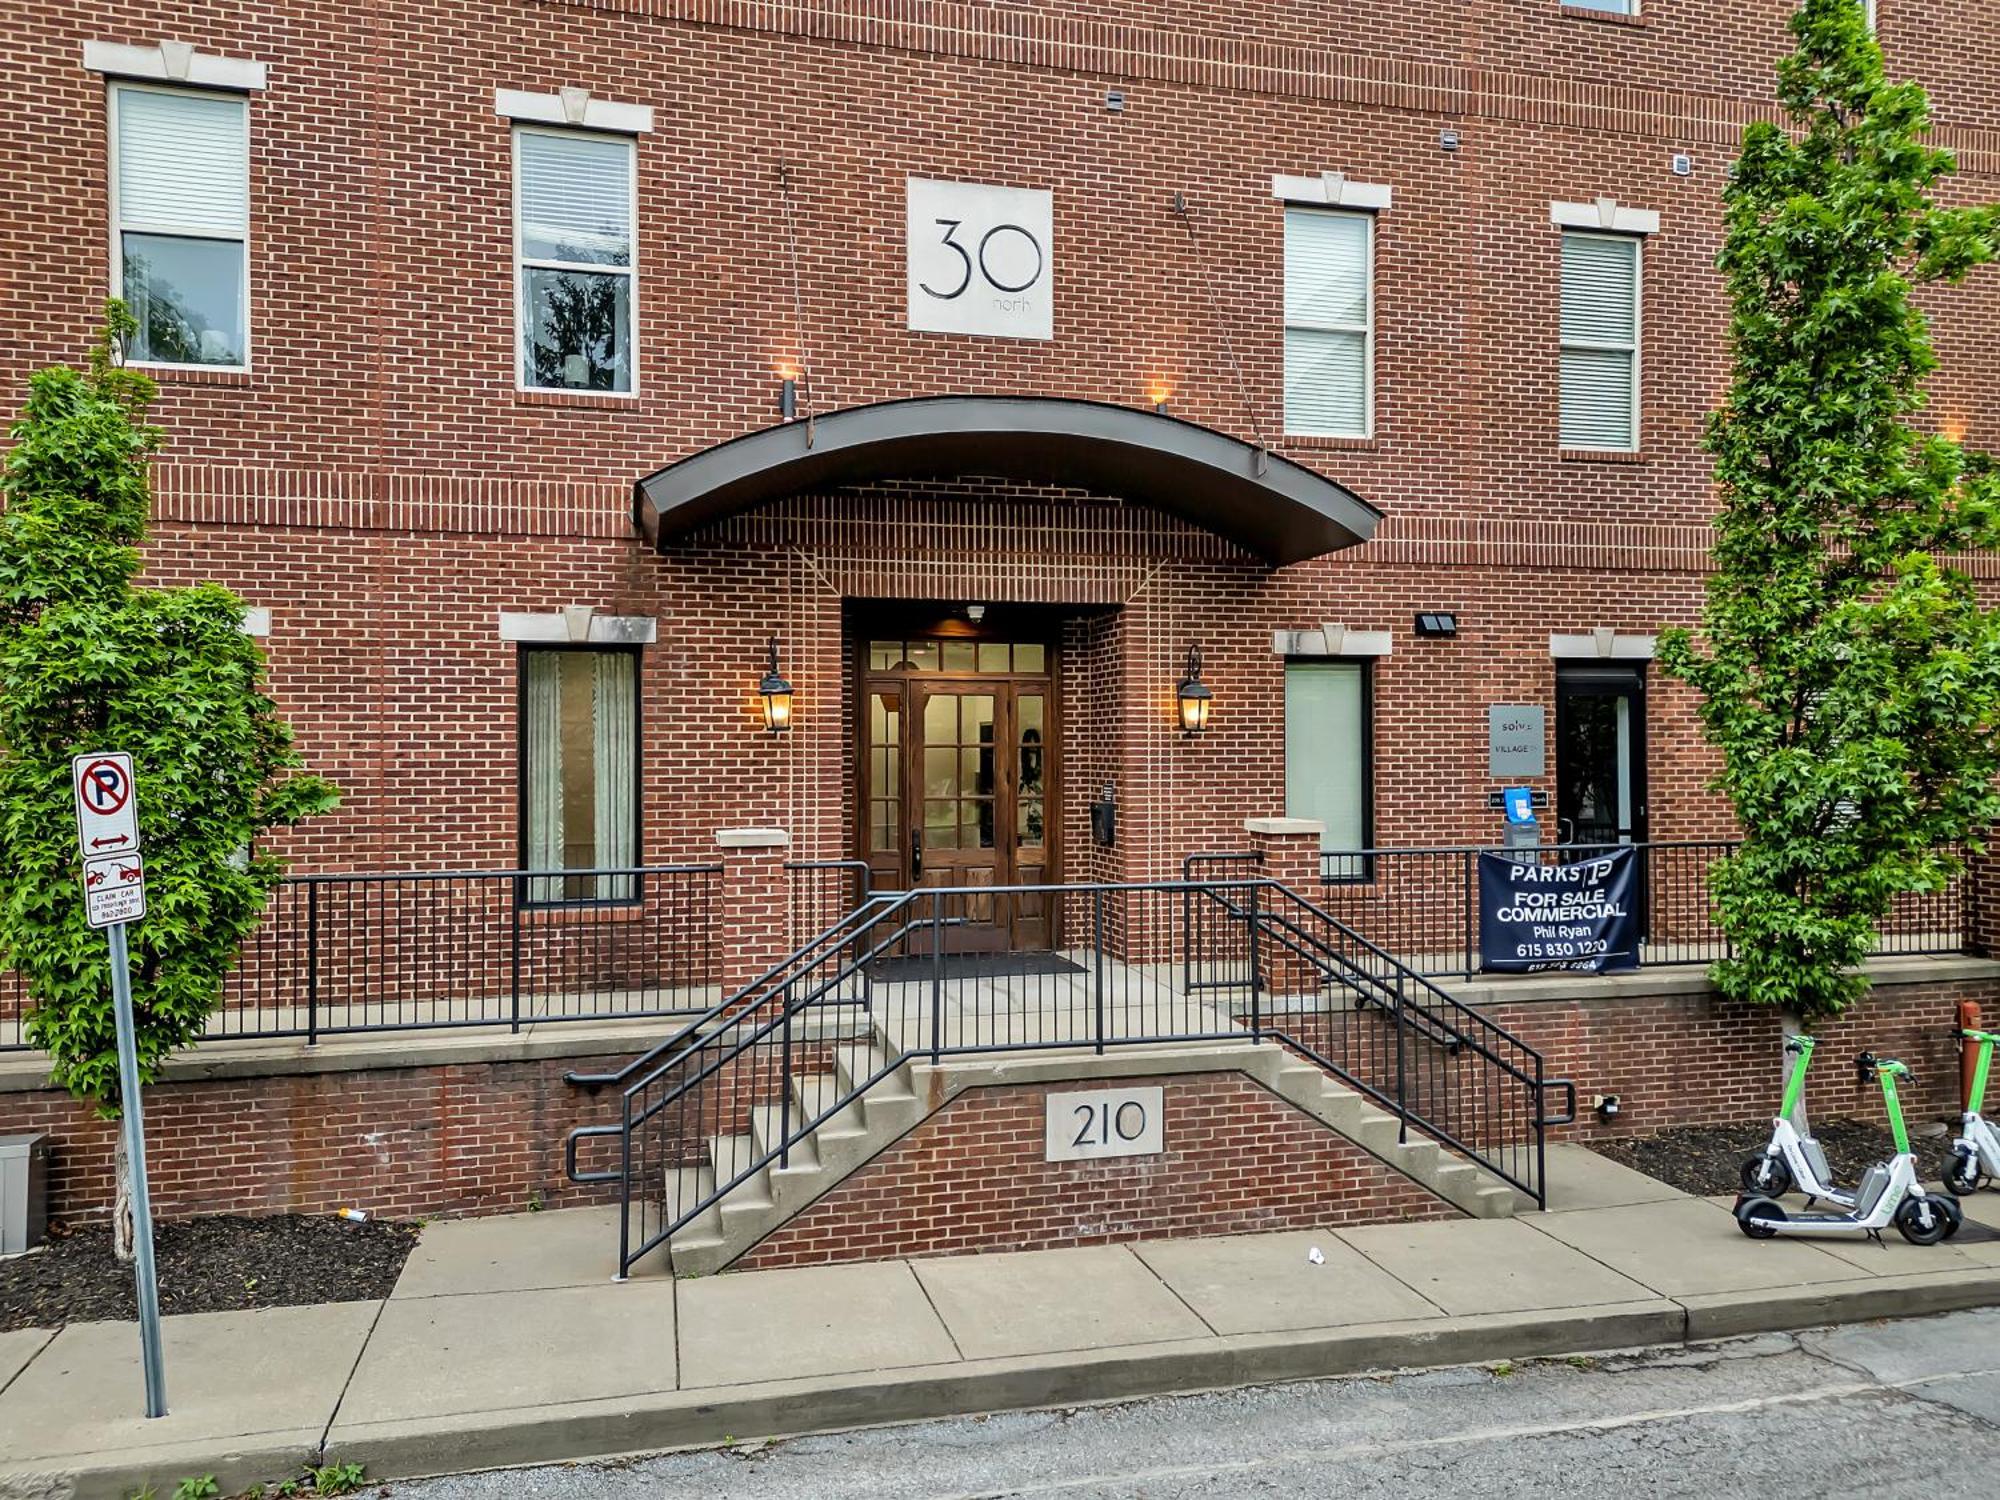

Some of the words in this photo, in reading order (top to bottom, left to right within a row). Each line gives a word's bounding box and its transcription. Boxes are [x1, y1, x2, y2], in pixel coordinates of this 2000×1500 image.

[919, 219, 1042, 300] 30
[1495, 744, 1529, 753] VILLAGE
[94, 770, 120, 806] P
[1510, 865, 1580, 882] PARKS
[121, 889, 134, 898] CAR
[1514, 892, 1558, 908] FOR
[1561, 889, 1605, 906] SALE
[1497, 903, 1627, 922] COMMERCIAL
[1533, 926, 1556, 938] Phil
[1558, 925, 1592, 939] Ryan
[1517, 944, 1542, 957] 615
[1546, 942, 1573, 956] 830
[1072, 1101, 1146, 1147] 210
